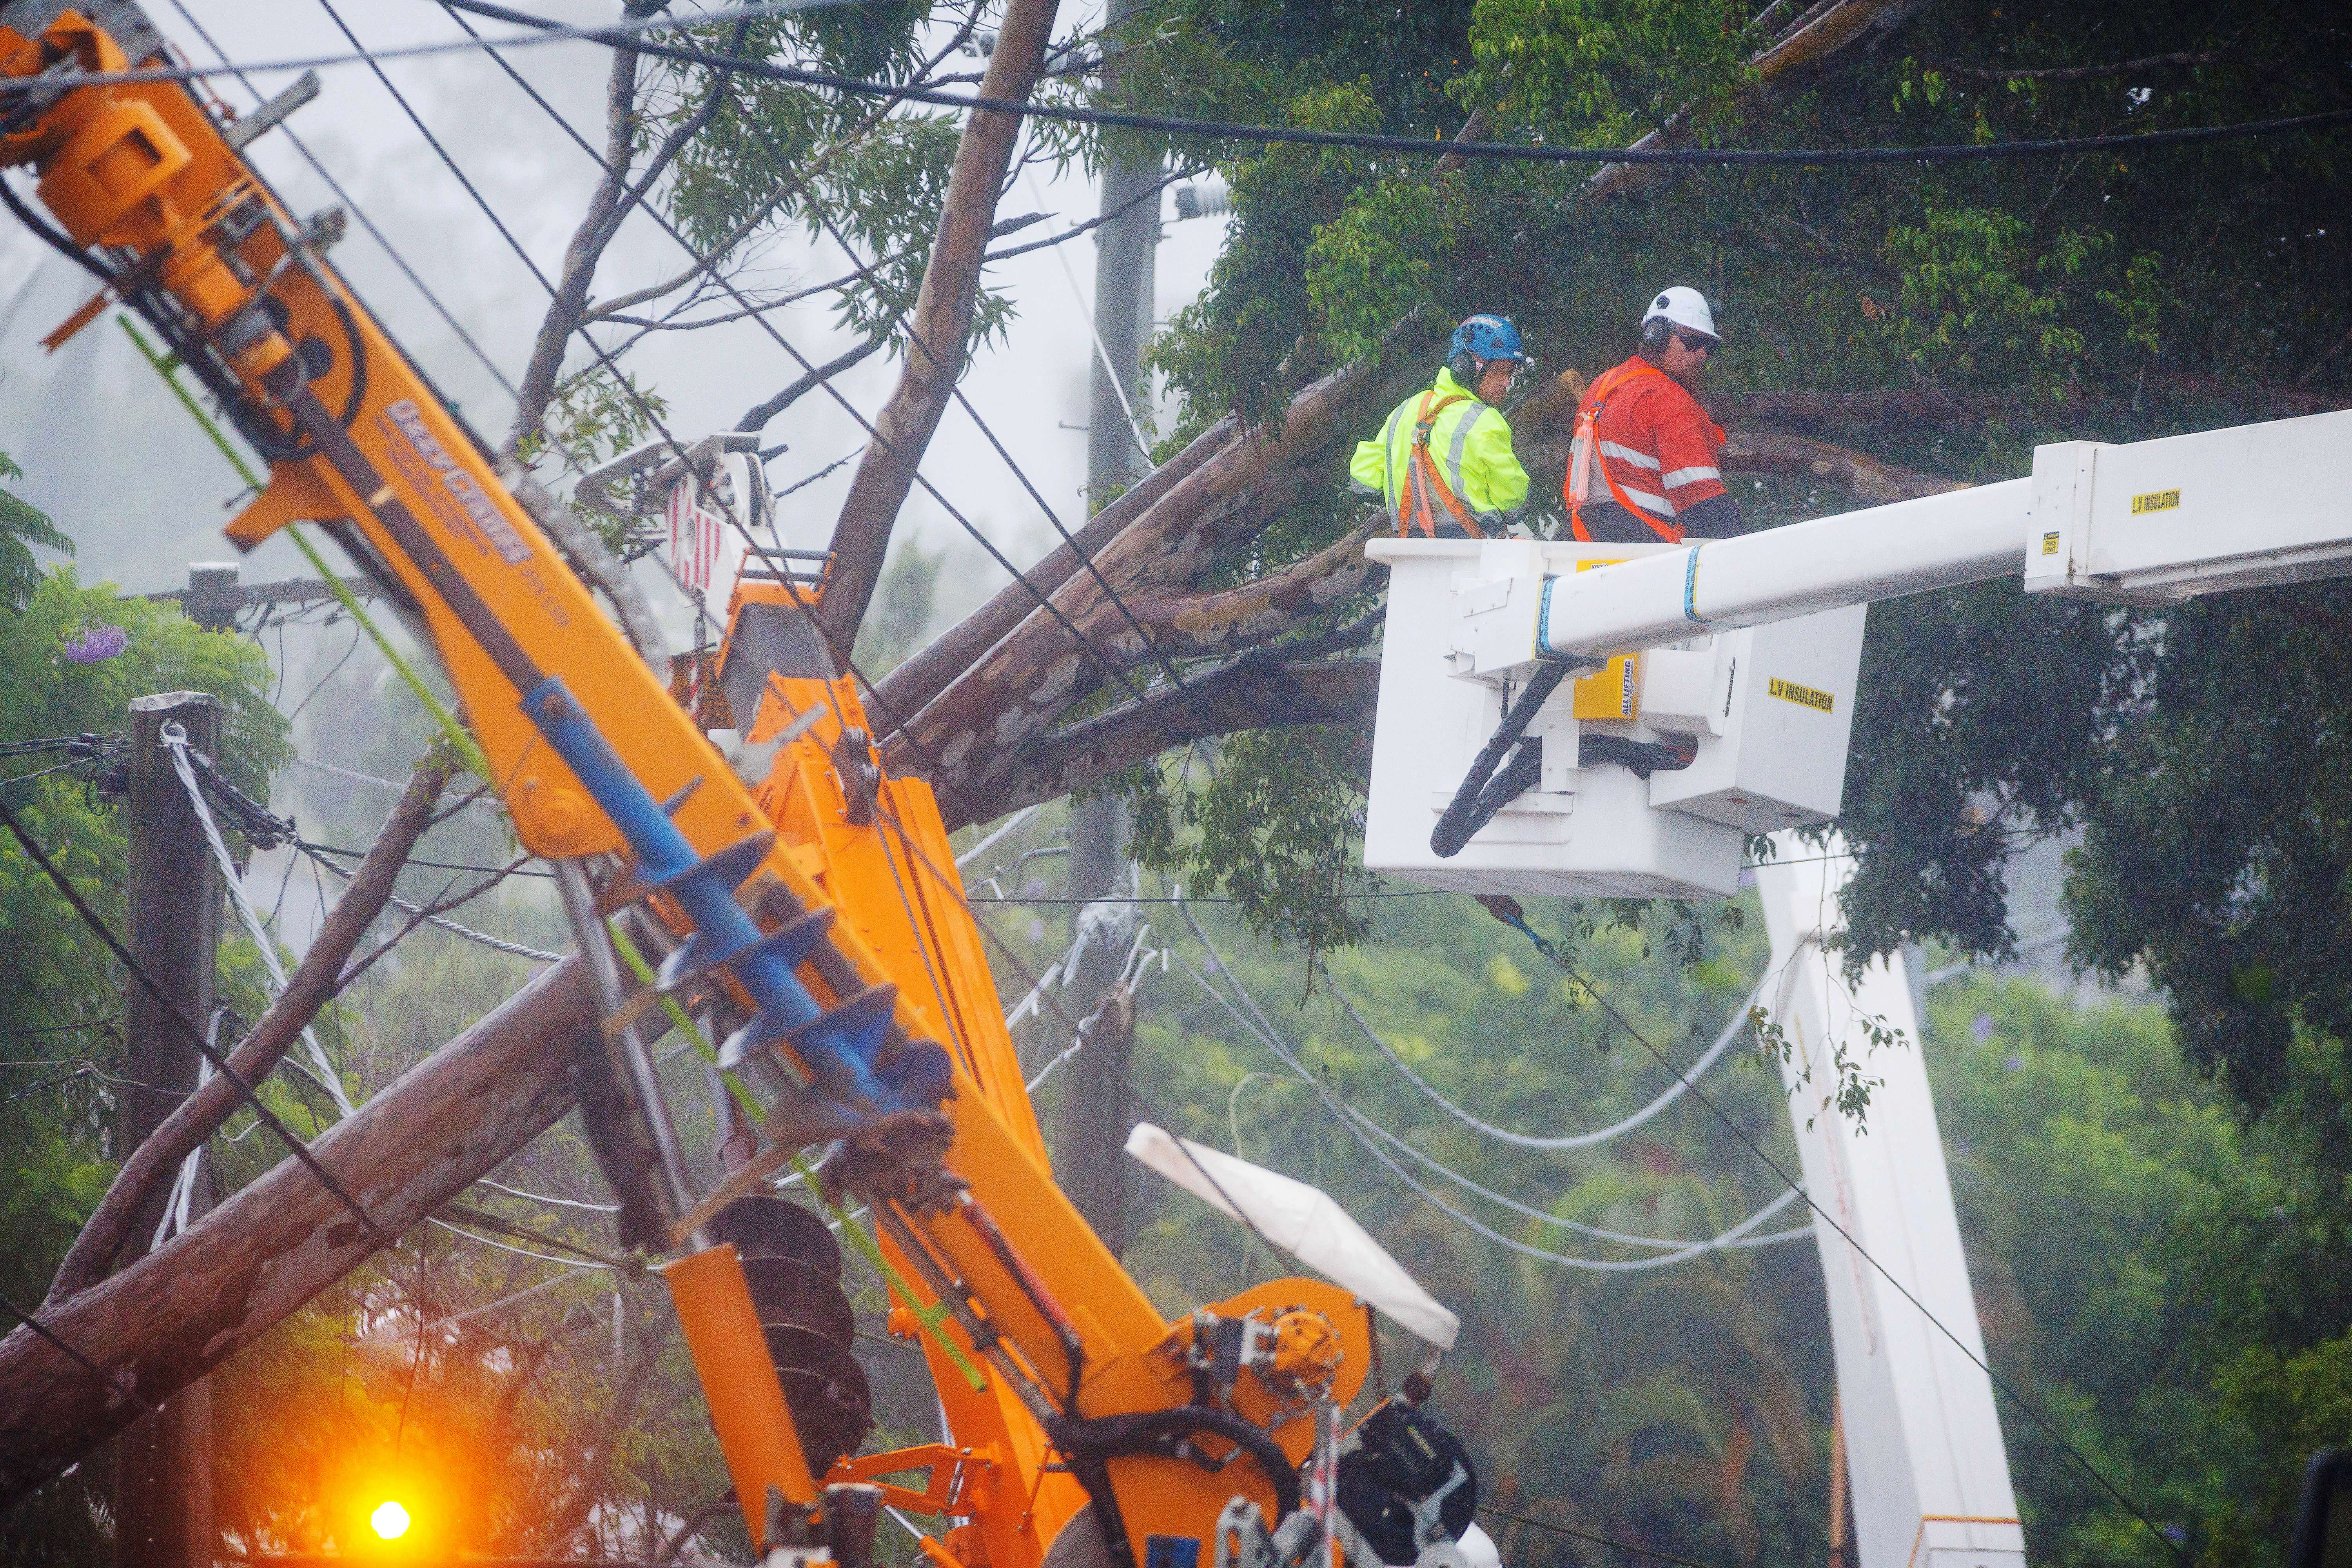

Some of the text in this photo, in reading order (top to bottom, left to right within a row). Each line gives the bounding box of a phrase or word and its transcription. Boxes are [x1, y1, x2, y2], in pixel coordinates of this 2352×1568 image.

[2144, 490, 2180, 512] INSULATION
[1622, 660, 1631, 697] LIFTING
[1770, 679, 1833, 711] L.V INSULATION
